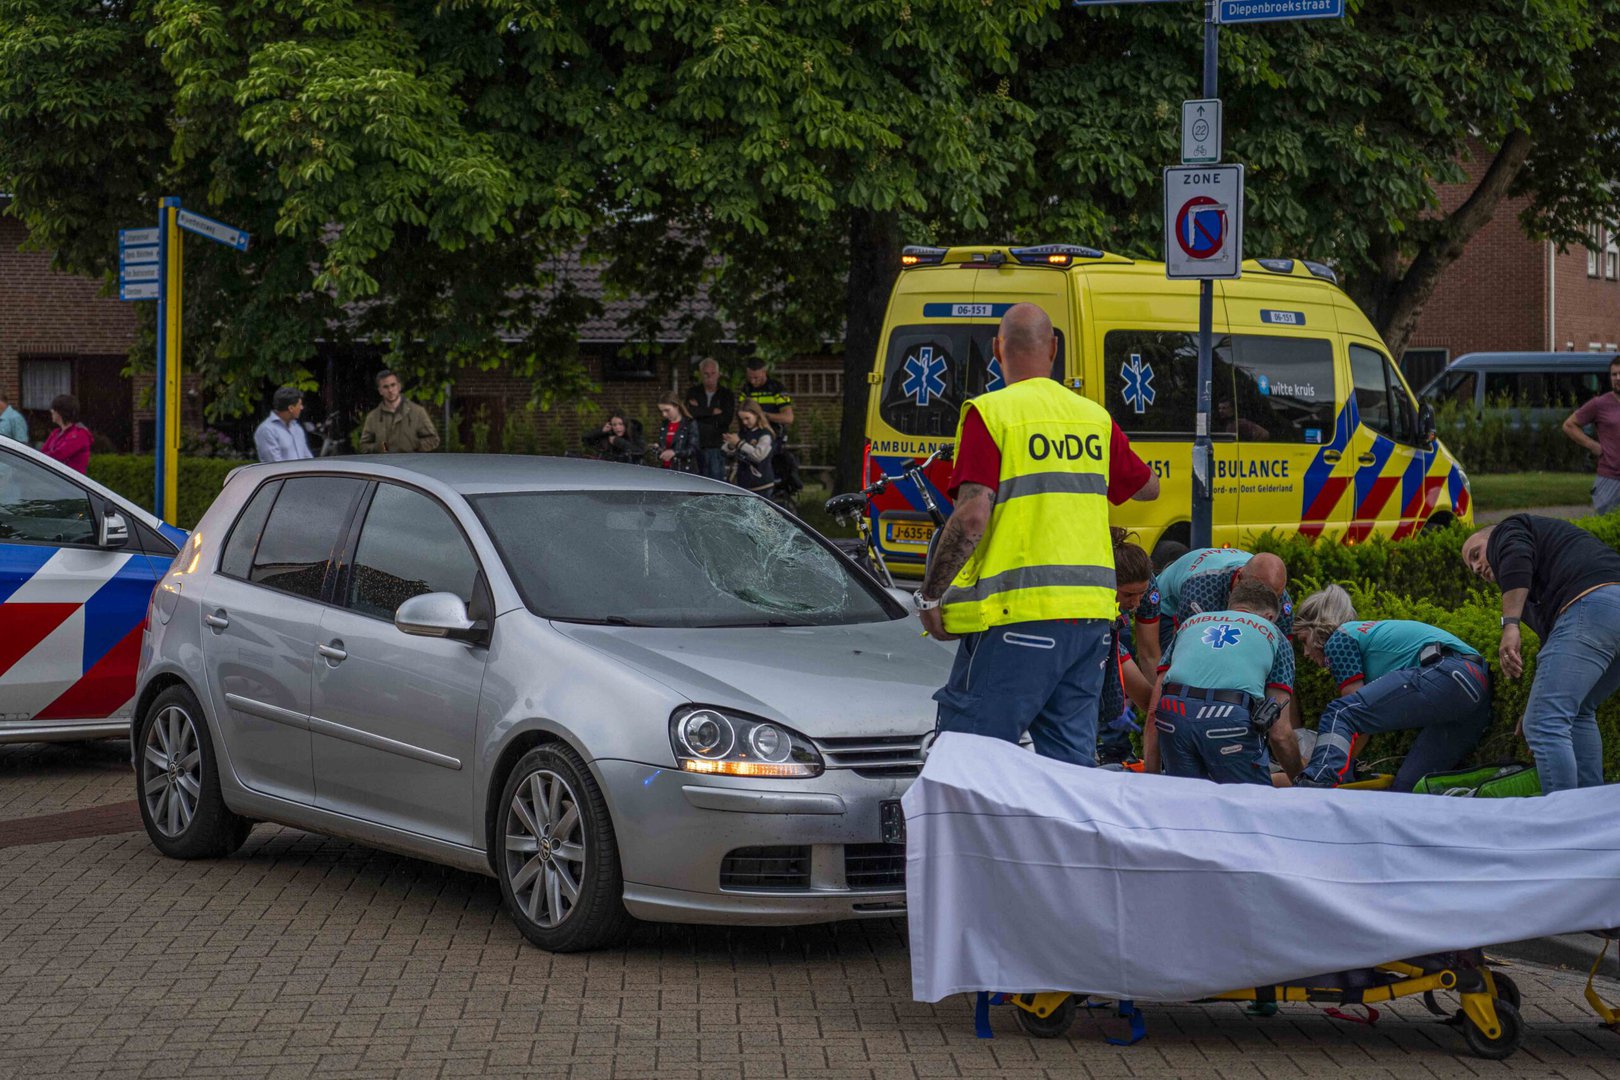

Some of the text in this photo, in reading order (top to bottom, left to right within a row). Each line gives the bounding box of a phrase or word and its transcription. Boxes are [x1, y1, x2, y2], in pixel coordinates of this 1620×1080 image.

[1228, 0, 1331, 16] Diepenbroekstraat
[1194, 125, 1206, 136] 22
[1183, 173, 1221, 185] ZONE
[957, 305, 987, 315] 06-151
[1273, 312, 1293, 322] 06-151
[1270, 381, 1315, 397] witte kruis
[871, 441, 952, 454] AMBULAN
[1028, 433, 1103, 461] OvDG
[1213, 460, 1289, 479] BULANCE
[1229, 486, 1238, 494] en
[1240, 484, 1256, 494] Oost
[1257, 484, 1293, 494] Gelderland
[1180, 615, 1275, 642] AMBULANCE
